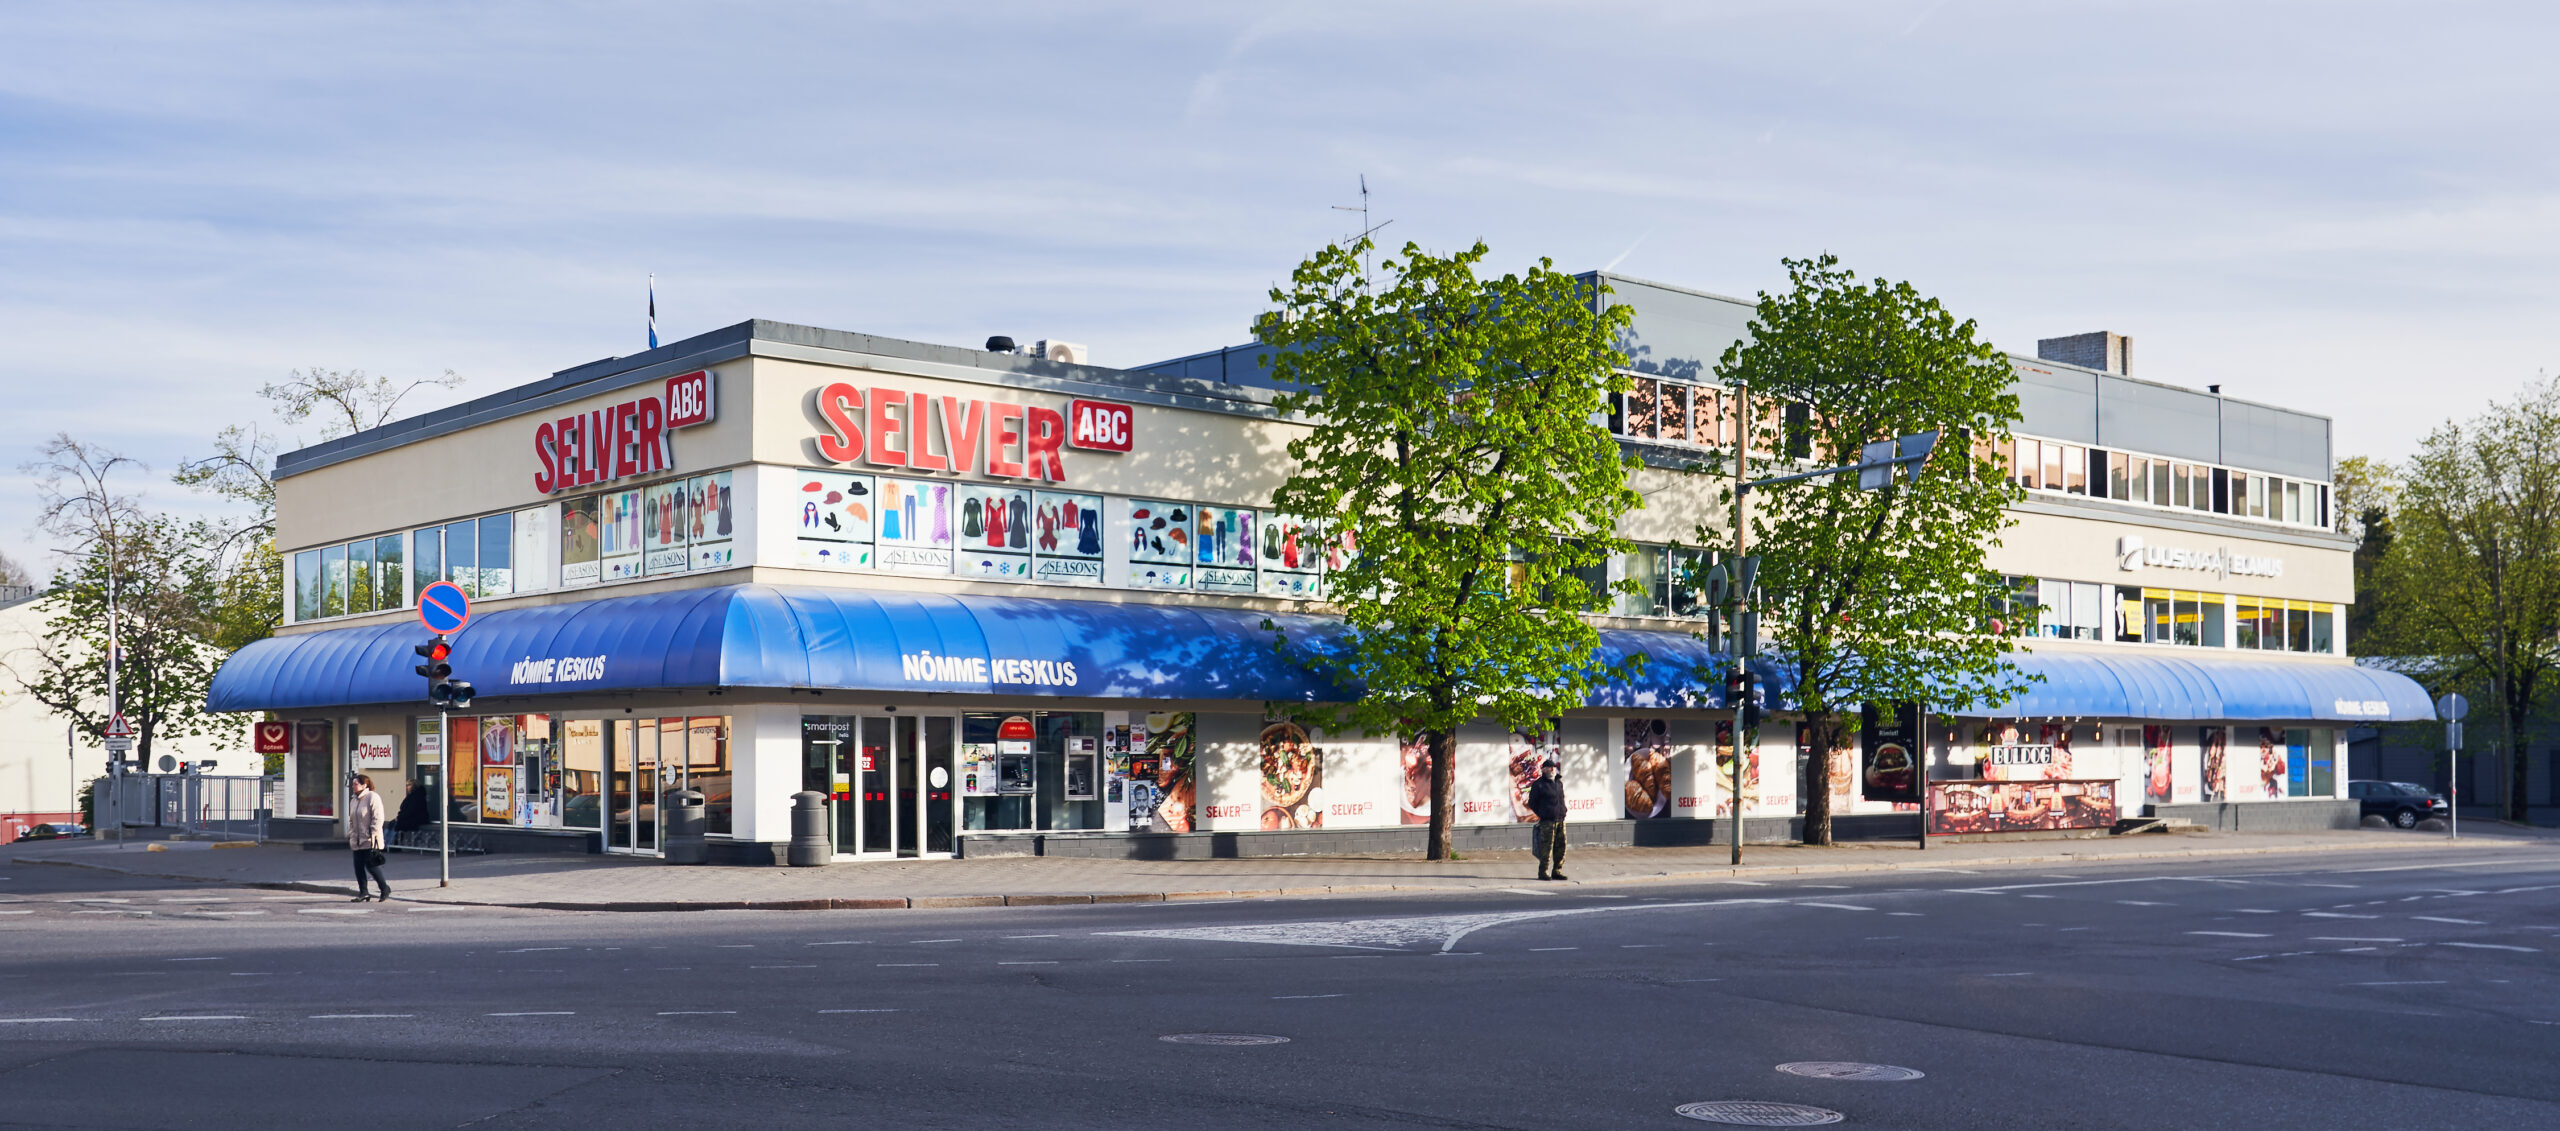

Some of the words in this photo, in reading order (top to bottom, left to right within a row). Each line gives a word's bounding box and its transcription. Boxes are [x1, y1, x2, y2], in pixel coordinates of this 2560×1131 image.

[534, 396, 668, 495] SELVER
[670, 378, 703, 423] ABC
[815, 382, 1066, 483] SELVER
[1077, 406, 1128, 446] ABC
[2144, 545, 2222, 572] UUSMAA
[510, 655, 556, 685] NÕMME
[555, 654, 607, 682] KESKUS
[901, 650, 988, 683] NÕMME
[991, 659, 1078, 687] KESKUS
[806, 722, 849, 733] smartpost
[262, 744, 285, 752] Apteek
[368, 744, 392, 761] Apteek
[1993, 746, 2050, 764] BULDOG
[1463, 801, 1492, 813] SELVER
[1568, 799, 1595, 810] SELVER
[1678, 797, 1703, 808] SELVER
[1766, 795, 1788, 806] SELVER
[1206, 805, 1240, 818] SELVER
[1331, 803, 1363, 816] SELVER
